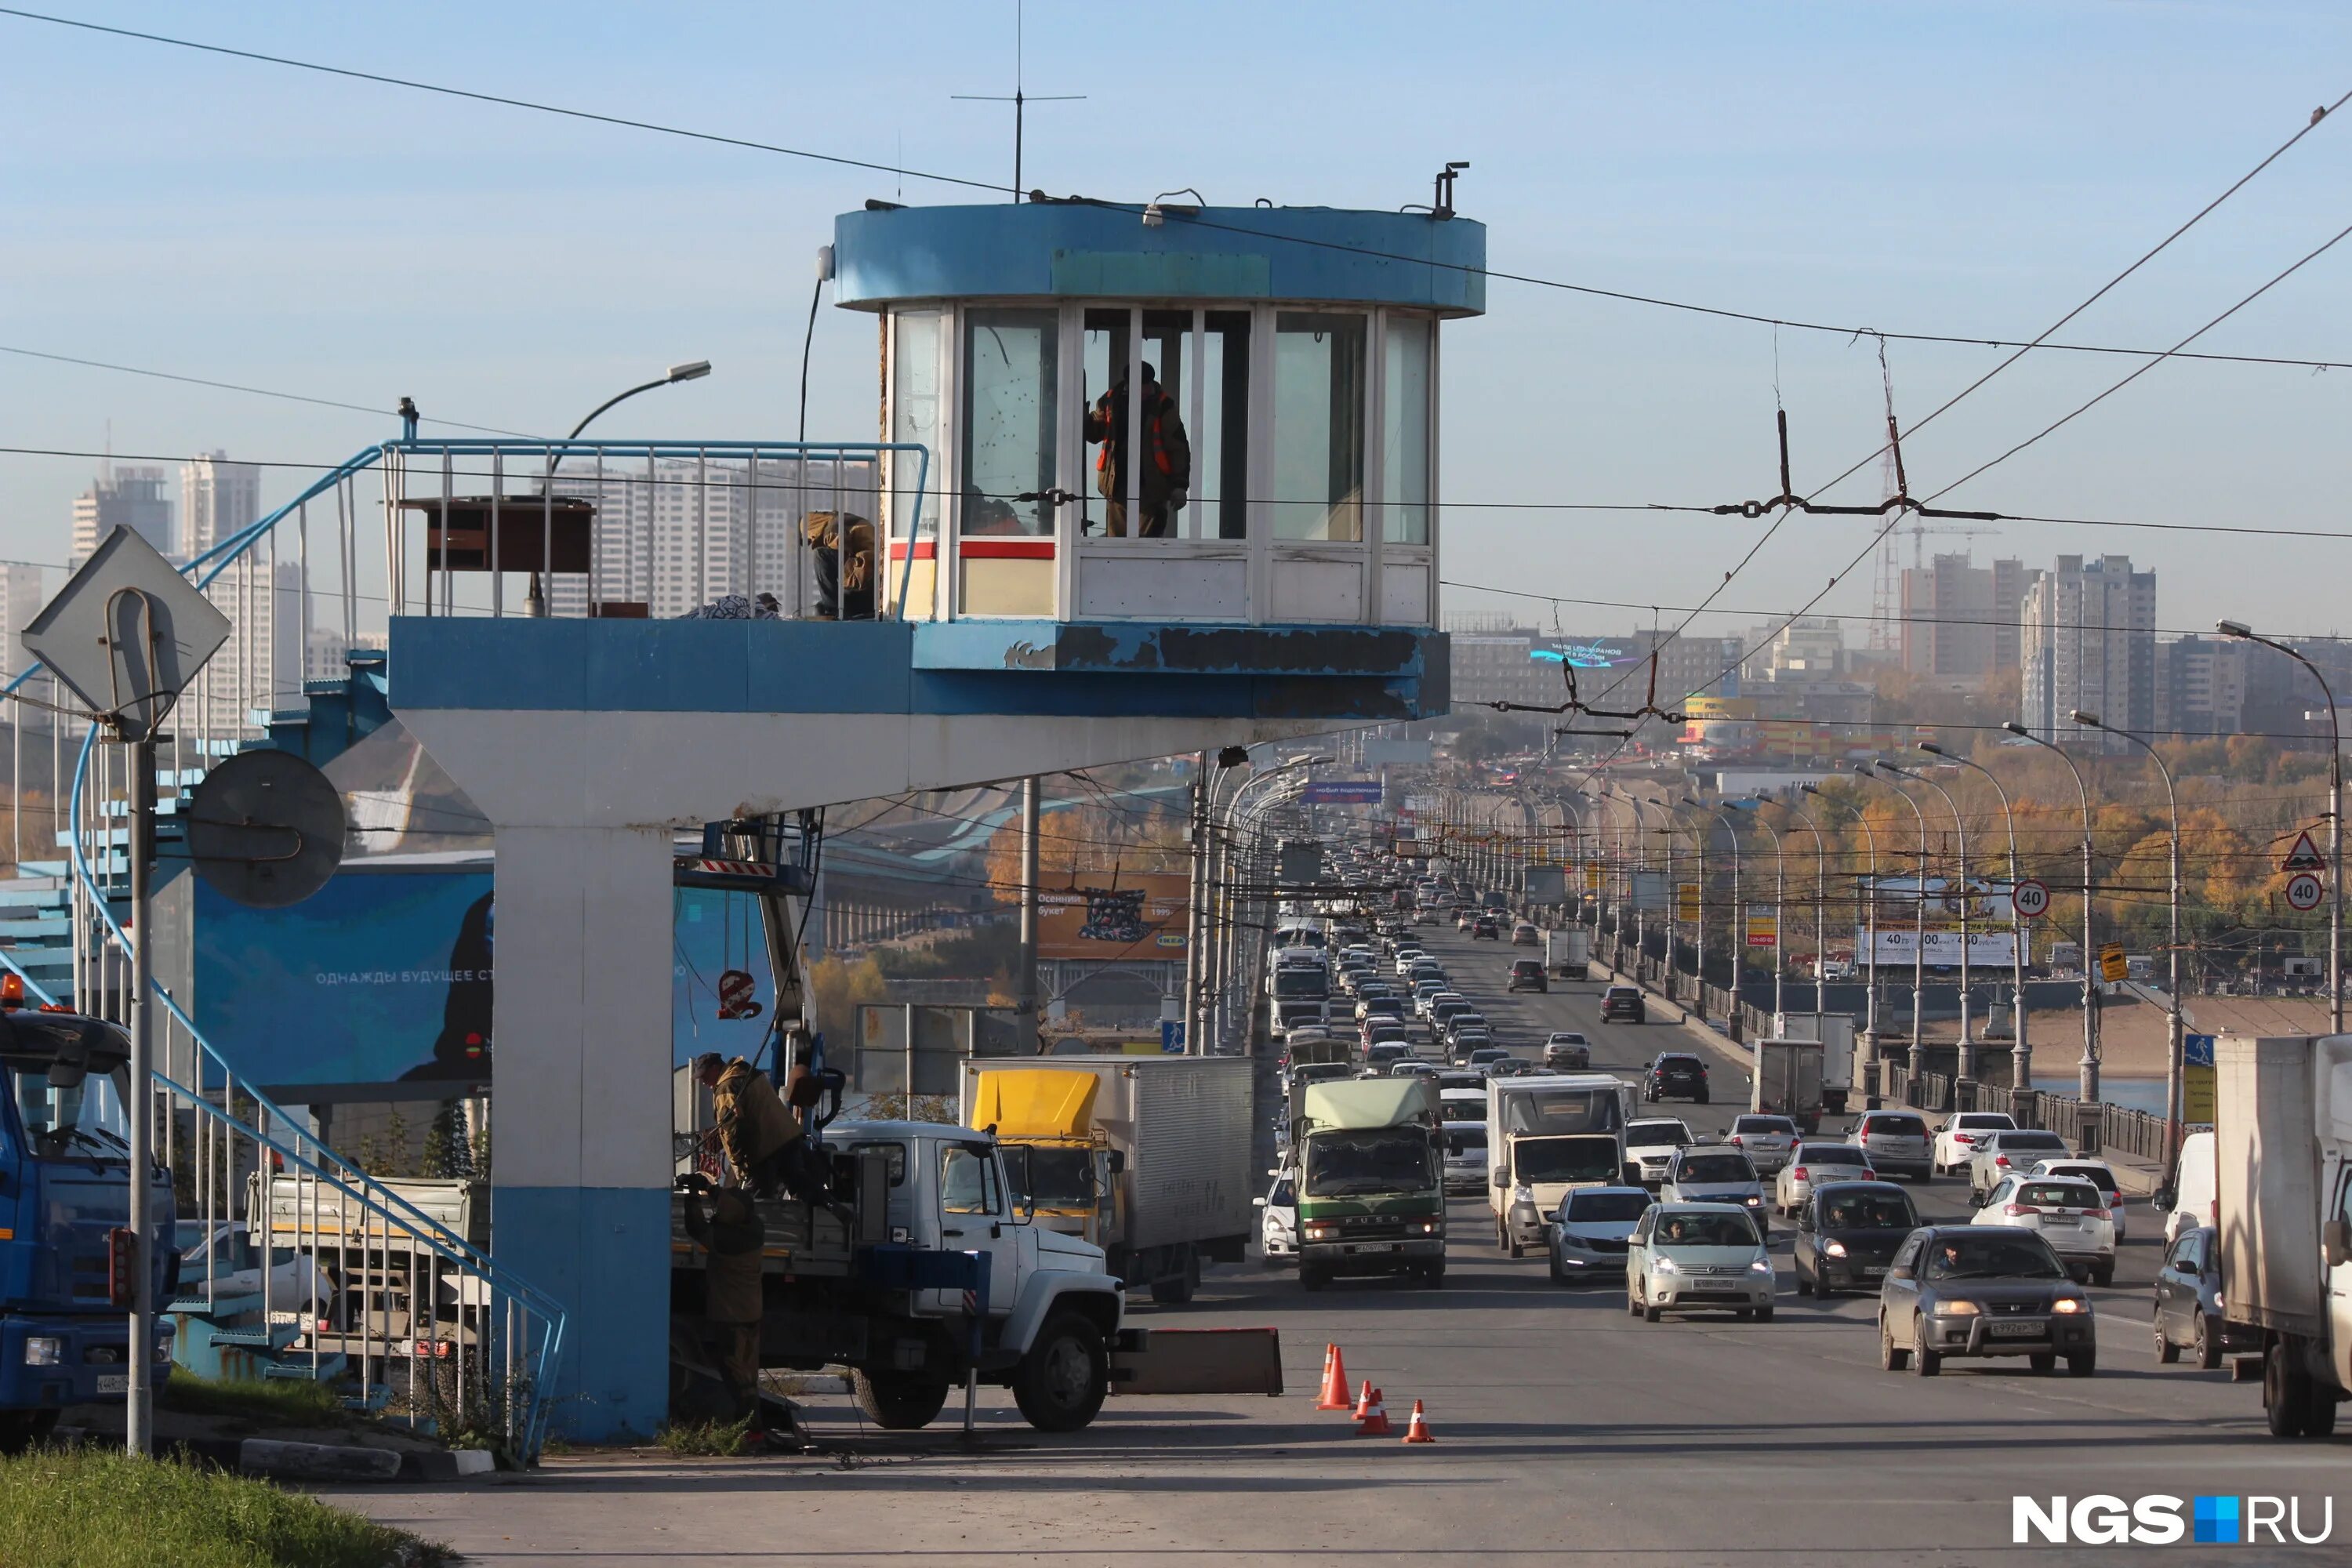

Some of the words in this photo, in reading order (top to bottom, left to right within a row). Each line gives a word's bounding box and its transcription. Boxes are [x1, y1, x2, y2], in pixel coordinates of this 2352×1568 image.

[2294, 884, 2314, 898] 40
[1038, 894, 1081, 903] Осенний
[2021, 891, 2041, 906] 40
[1038, 906, 1065, 917] букет
[1886, 934, 1900, 944] 40
[316, 972, 396, 985] ОДНАЖДЫ
[401, 970, 473, 985] БУДУЩЕЕ
